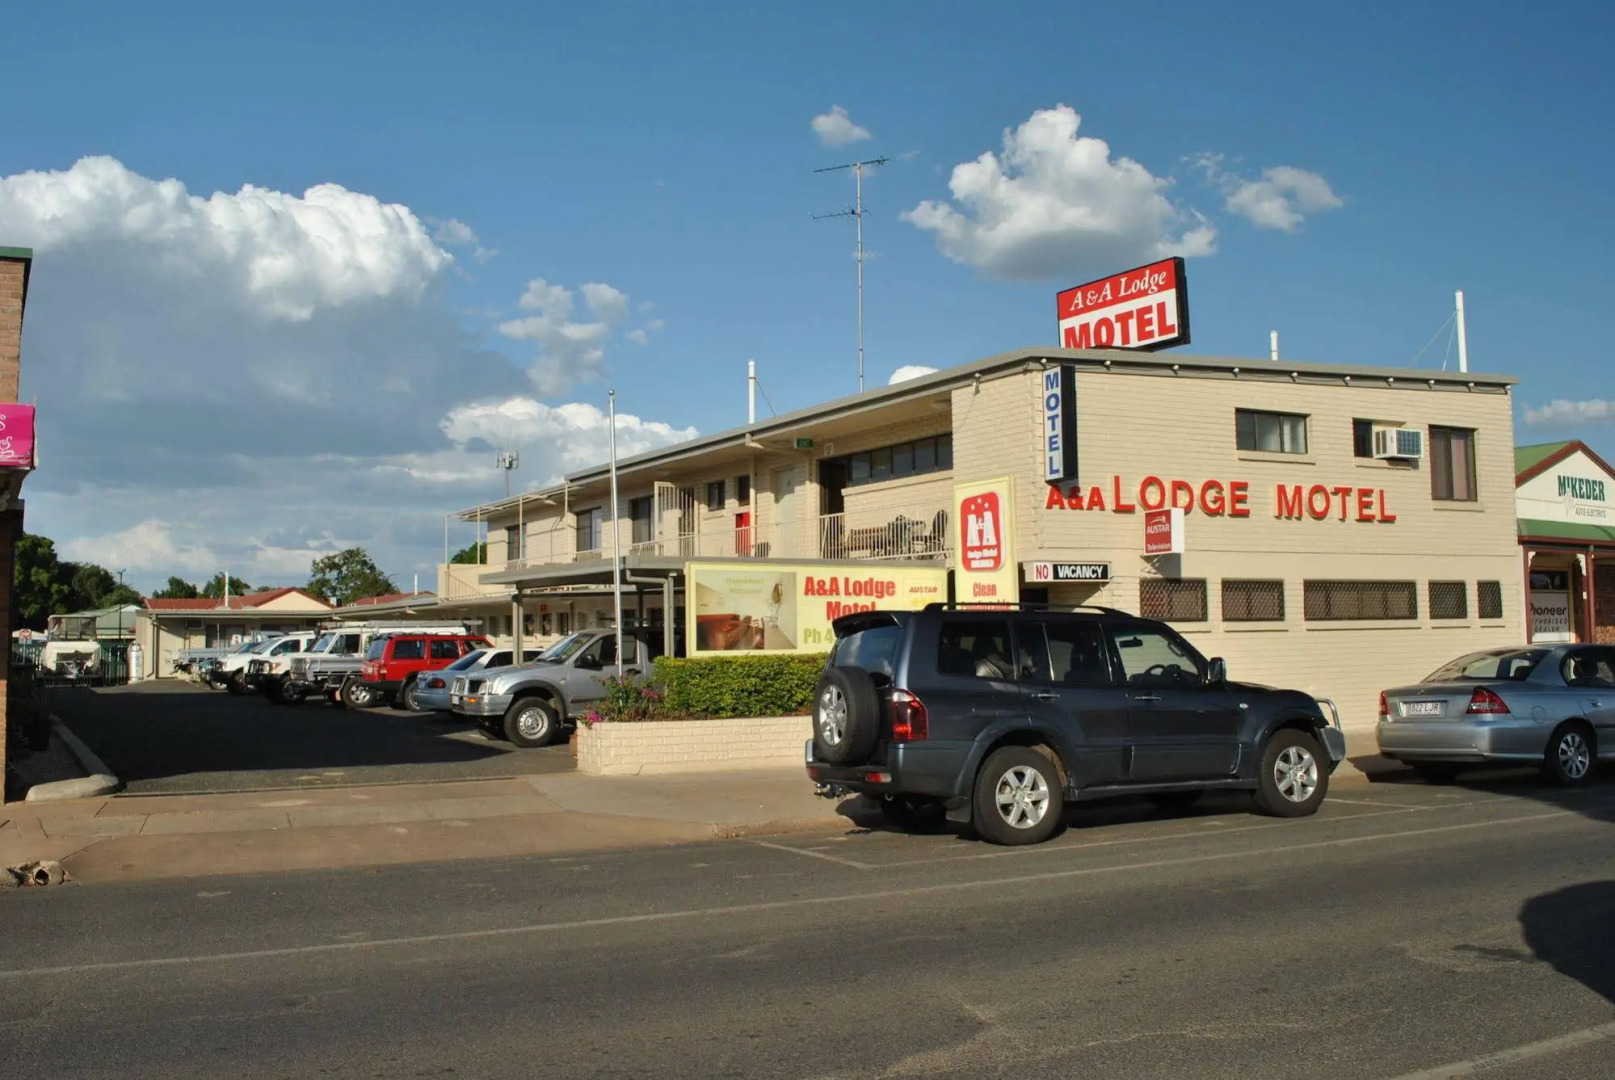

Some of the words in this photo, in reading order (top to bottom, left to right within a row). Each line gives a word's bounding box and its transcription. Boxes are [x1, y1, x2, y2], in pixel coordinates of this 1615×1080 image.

[1070, 284, 1112, 311] A&A
[1119, 269, 1167, 295] Lodge
[1064, 301, 1176, 349] MOTEL
[1045, 371, 1061, 475] MOTEL
[1045, 484, 1106, 511] A&A
[1113, 475, 1250, 517] LODGE
[1275, 484, 1397, 521] MOTEL
[1146, 523, 1170, 535] AUSTAR
[1147, 543, 1171, 551] Television
[1036, 565, 1049, 579] NO
[1058, 565, 1104, 579] VACANCY
[804, 576, 840, 596] A&A
[844, 577, 896, 599] Lodge
[909, 586, 938, 594] AUSTAR
[973, 583, 997, 597] Clean
[1531, 617, 1568, 625] THORISED
[804, 628, 821, 644] Ph
